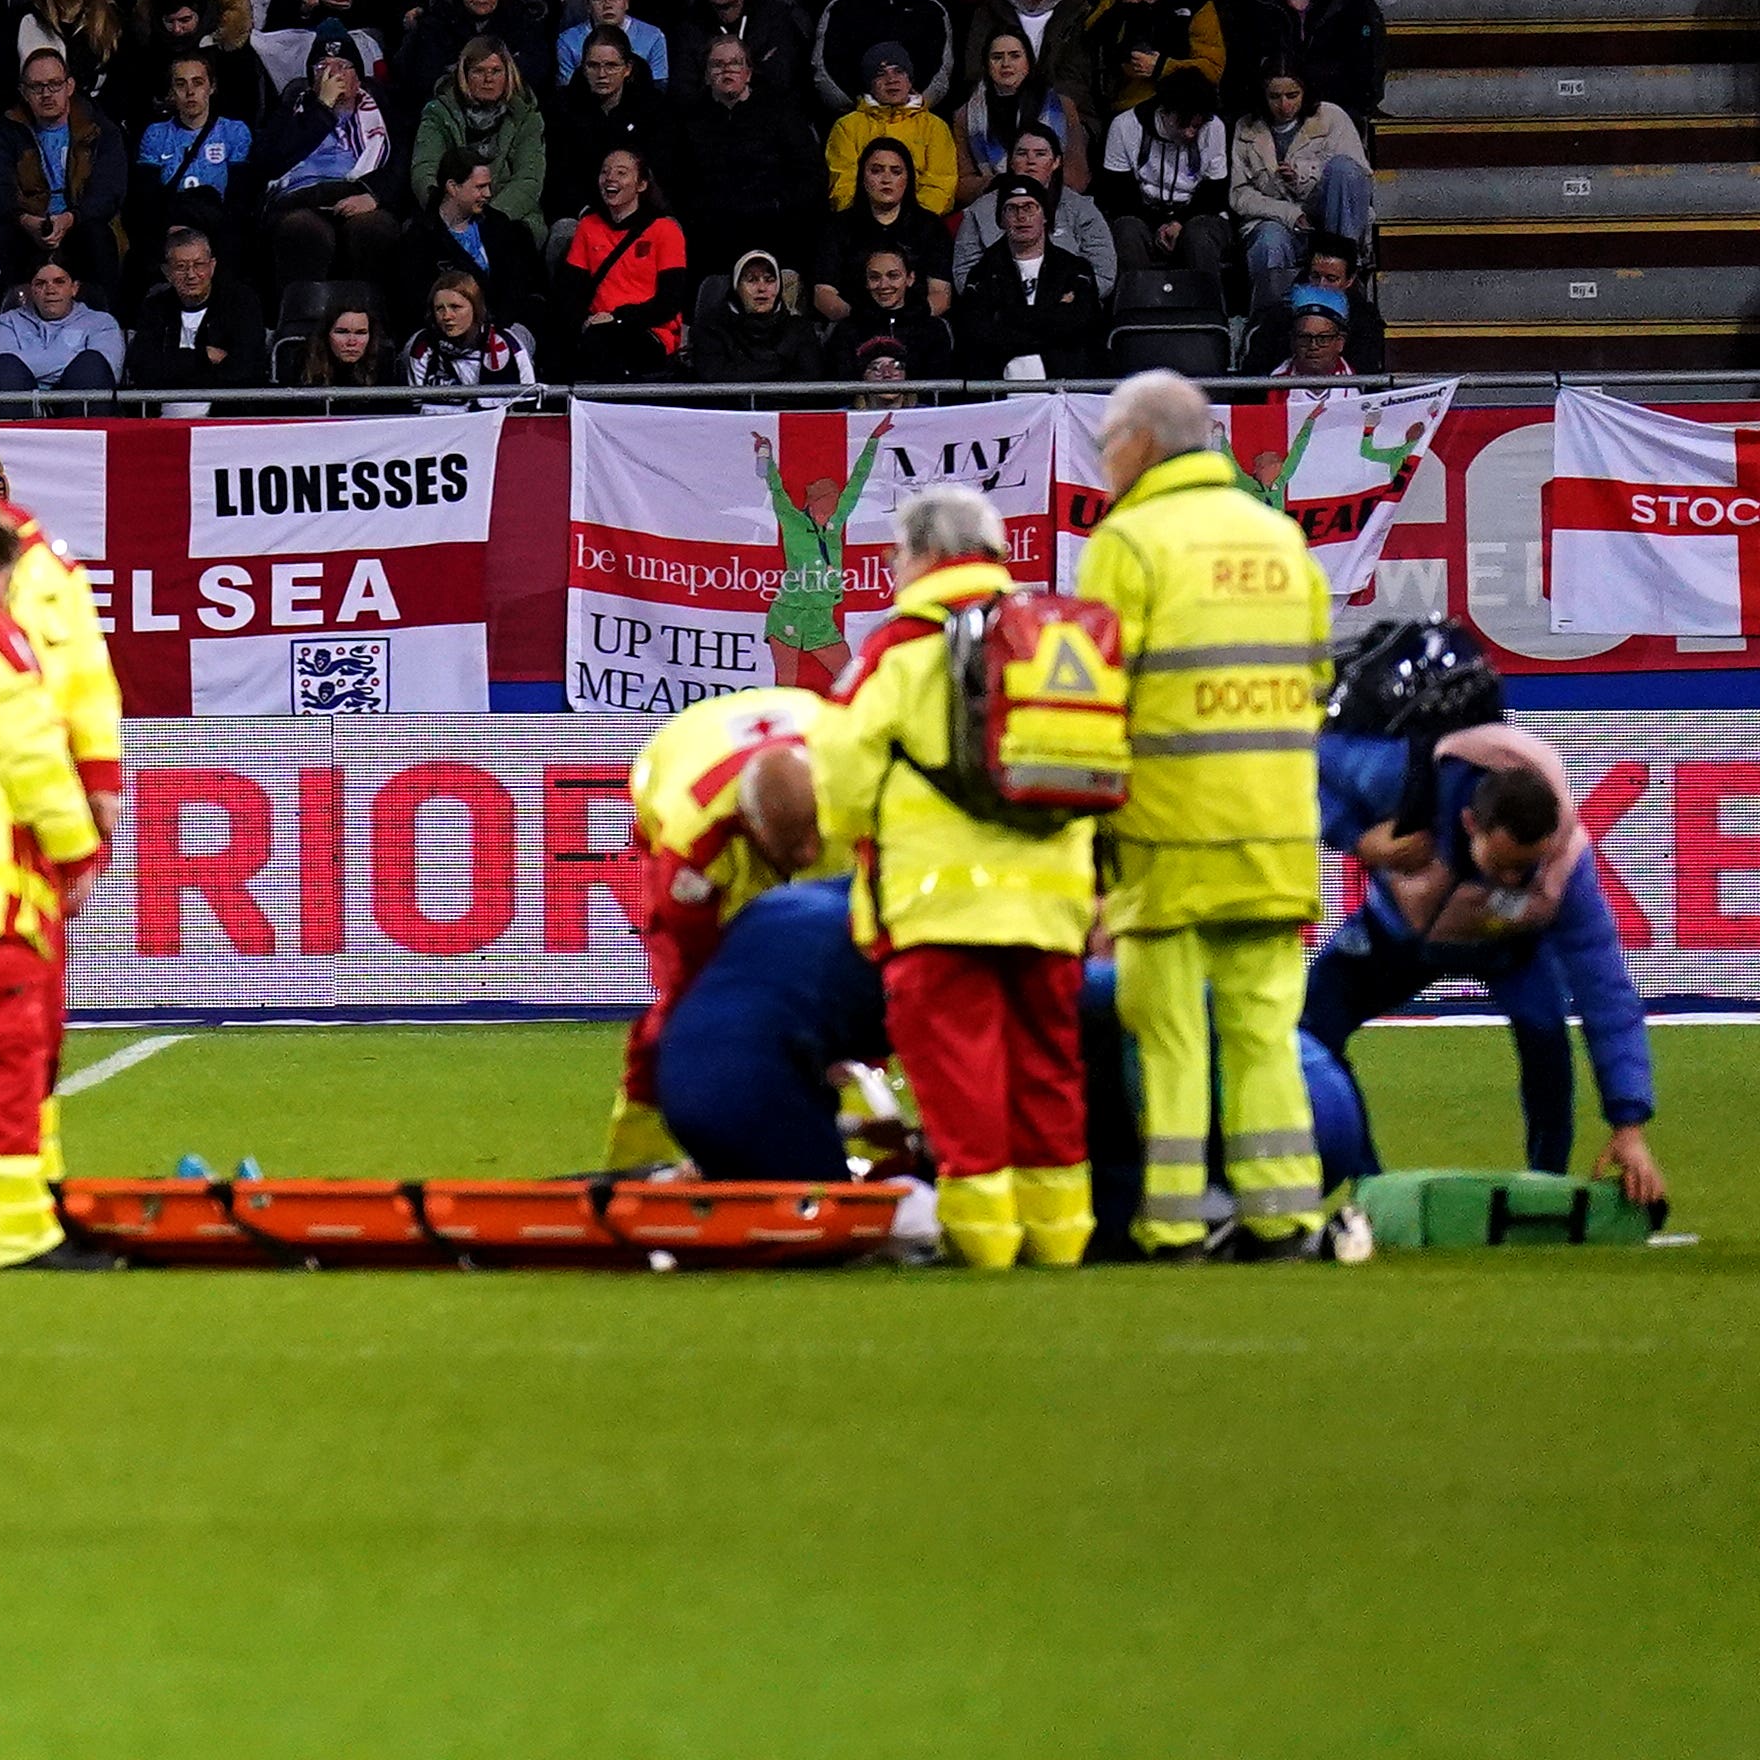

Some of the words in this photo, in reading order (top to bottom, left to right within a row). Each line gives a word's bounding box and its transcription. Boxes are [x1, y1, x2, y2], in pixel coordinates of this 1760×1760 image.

[1572, 286, 1586, 297] Rij
[213, 452, 469, 518] LIONESSES
[82, 558, 402, 634] ELSEA
[575, 533, 617, 574] be
[625, 552, 898, 602] unapologetically
[1212, 557, 1290, 595] RED
[590, 611, 653, 660] UP
[660, 624, 758, 673] THE
